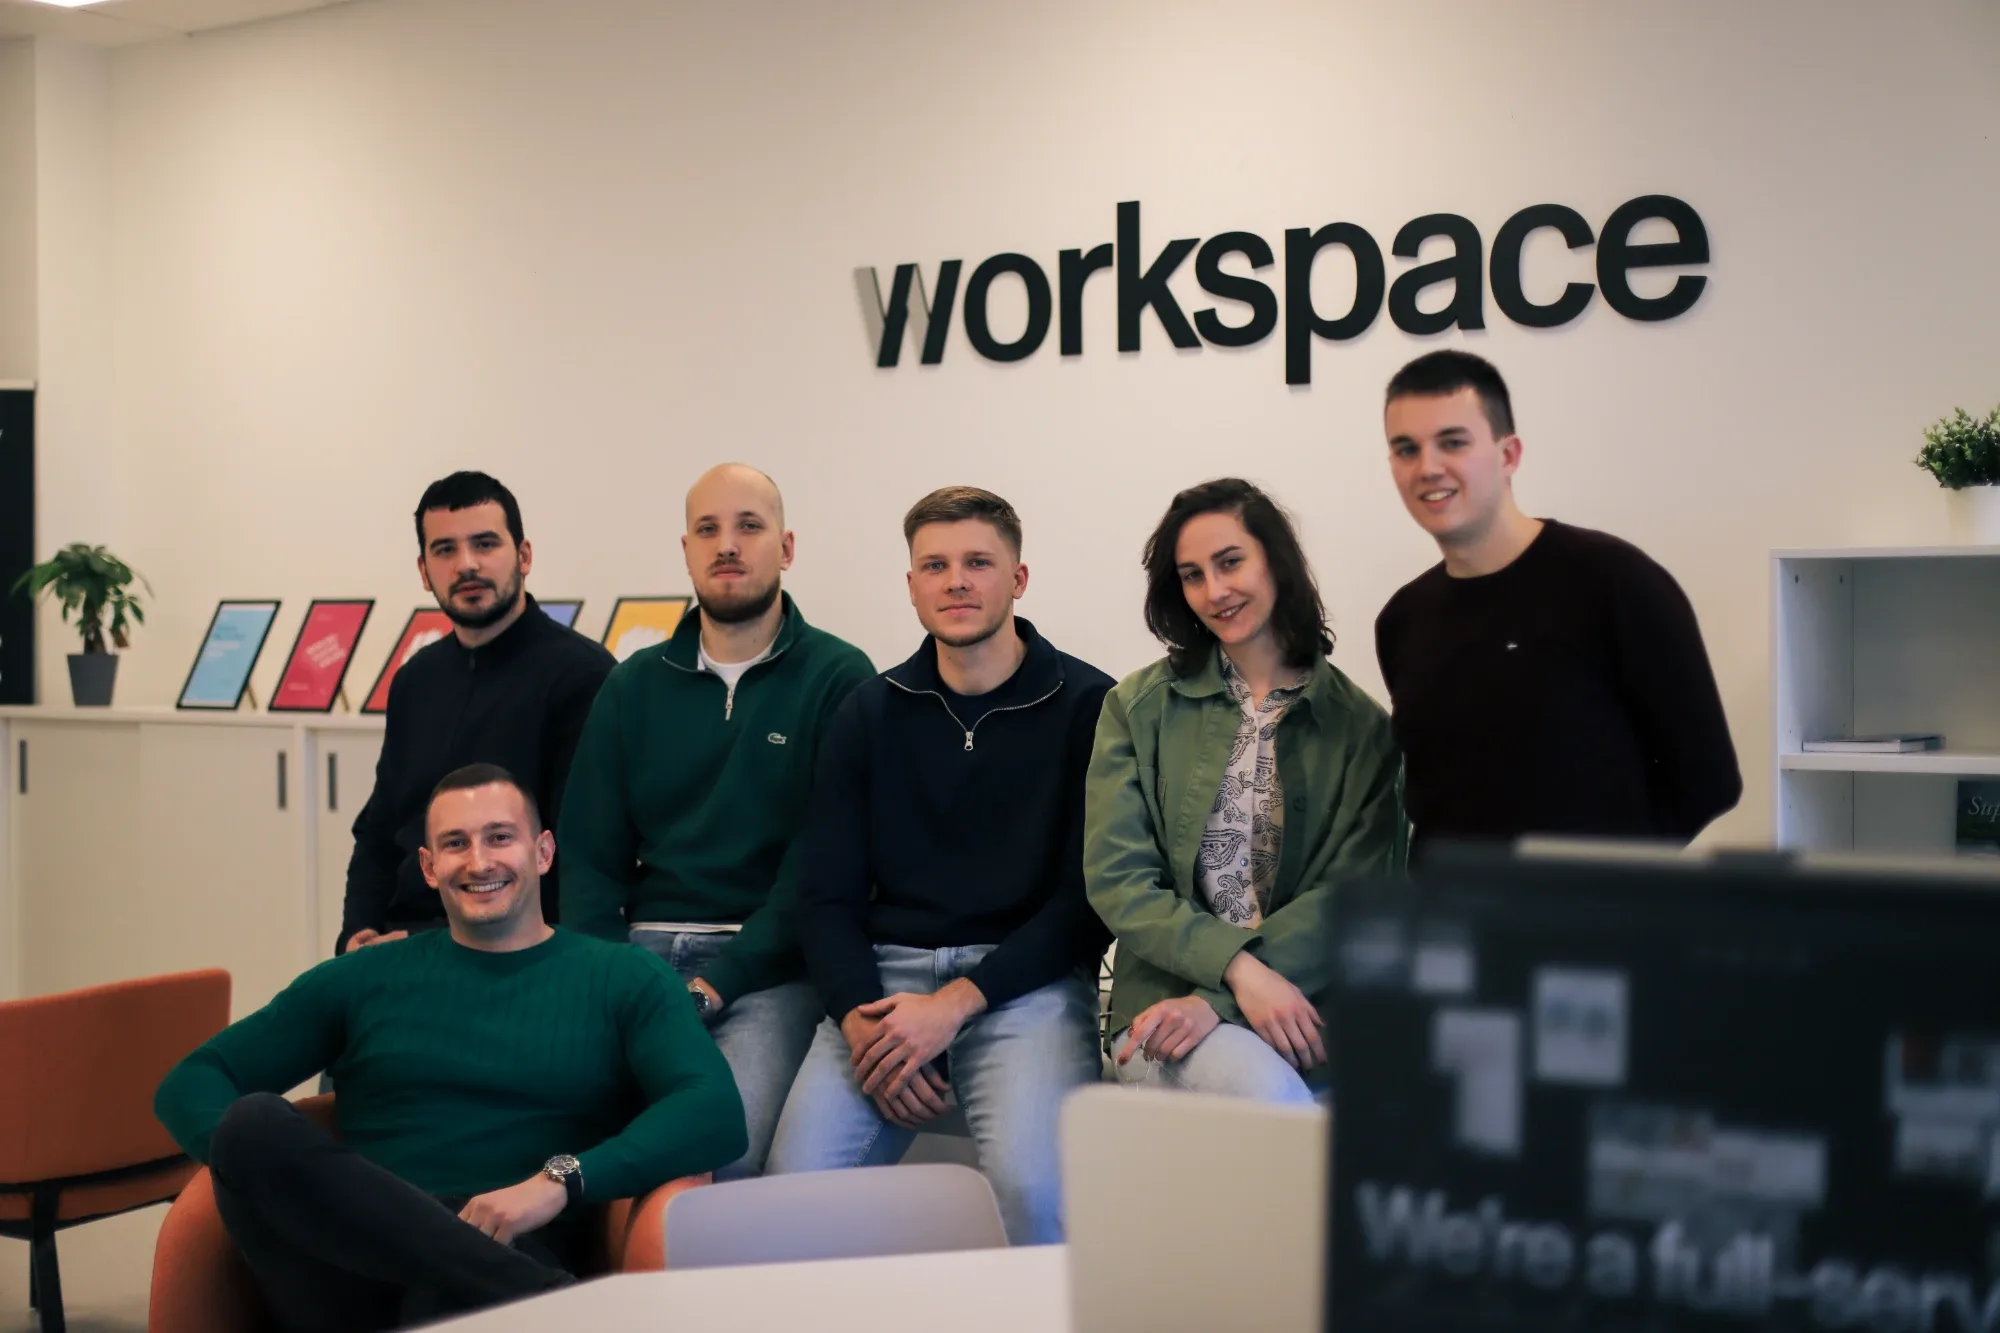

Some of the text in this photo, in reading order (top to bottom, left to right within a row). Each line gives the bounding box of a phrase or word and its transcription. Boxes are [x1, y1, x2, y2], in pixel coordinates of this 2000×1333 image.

[853, 194, 1711, 385] workspace
[1354, 1180, 1575, 1289] We're
[1585, 1229, 1638, 1299] a
